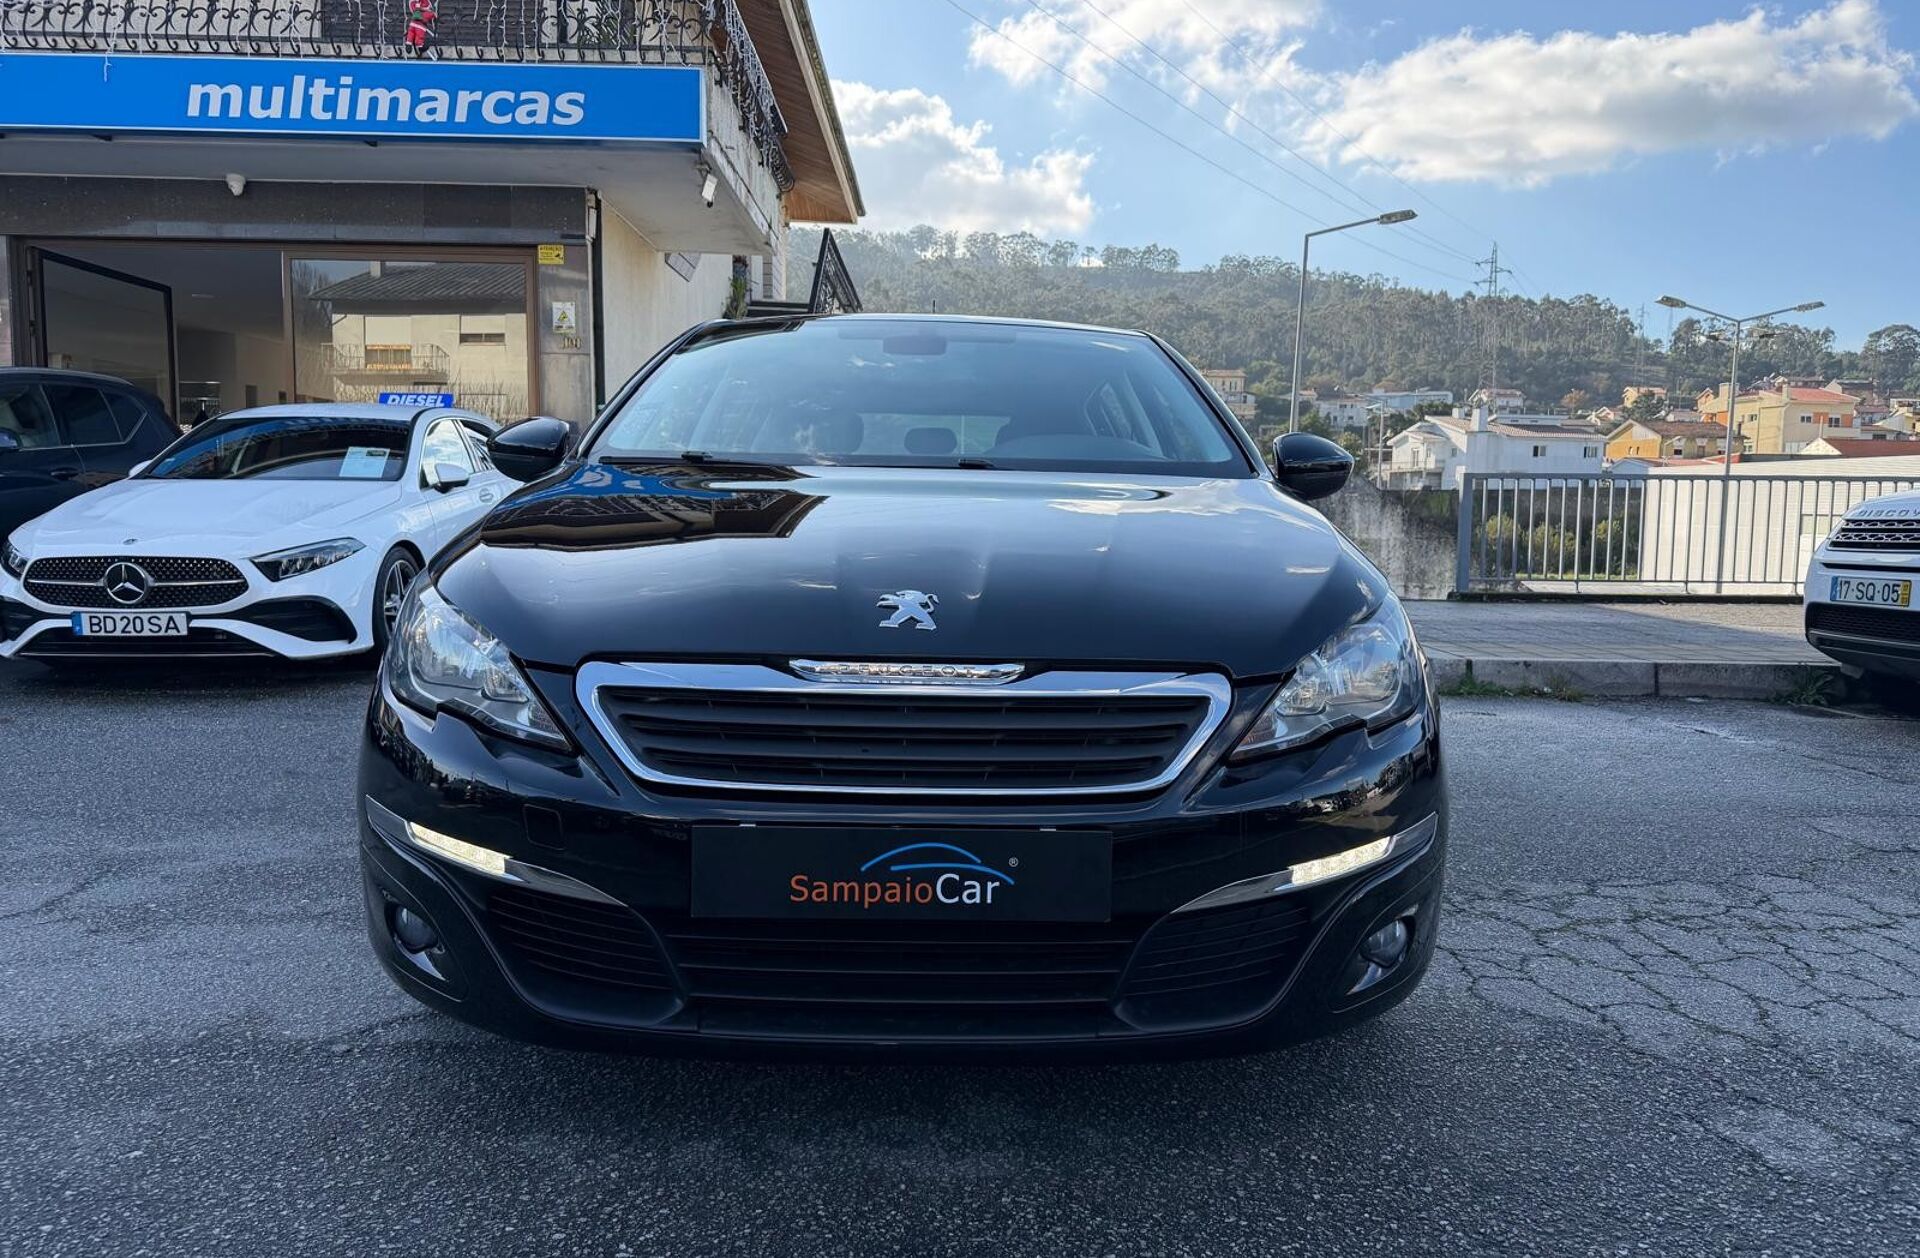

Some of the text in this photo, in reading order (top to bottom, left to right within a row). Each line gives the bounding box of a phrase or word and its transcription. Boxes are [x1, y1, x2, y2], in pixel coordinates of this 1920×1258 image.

[187, 75, 585, 126] multimarcas
[387, 394, 445, 407] DIESEL
[837, 663, 977, 677] PEUGEOT
[790, 873, 1000, 909] SampaioCar
